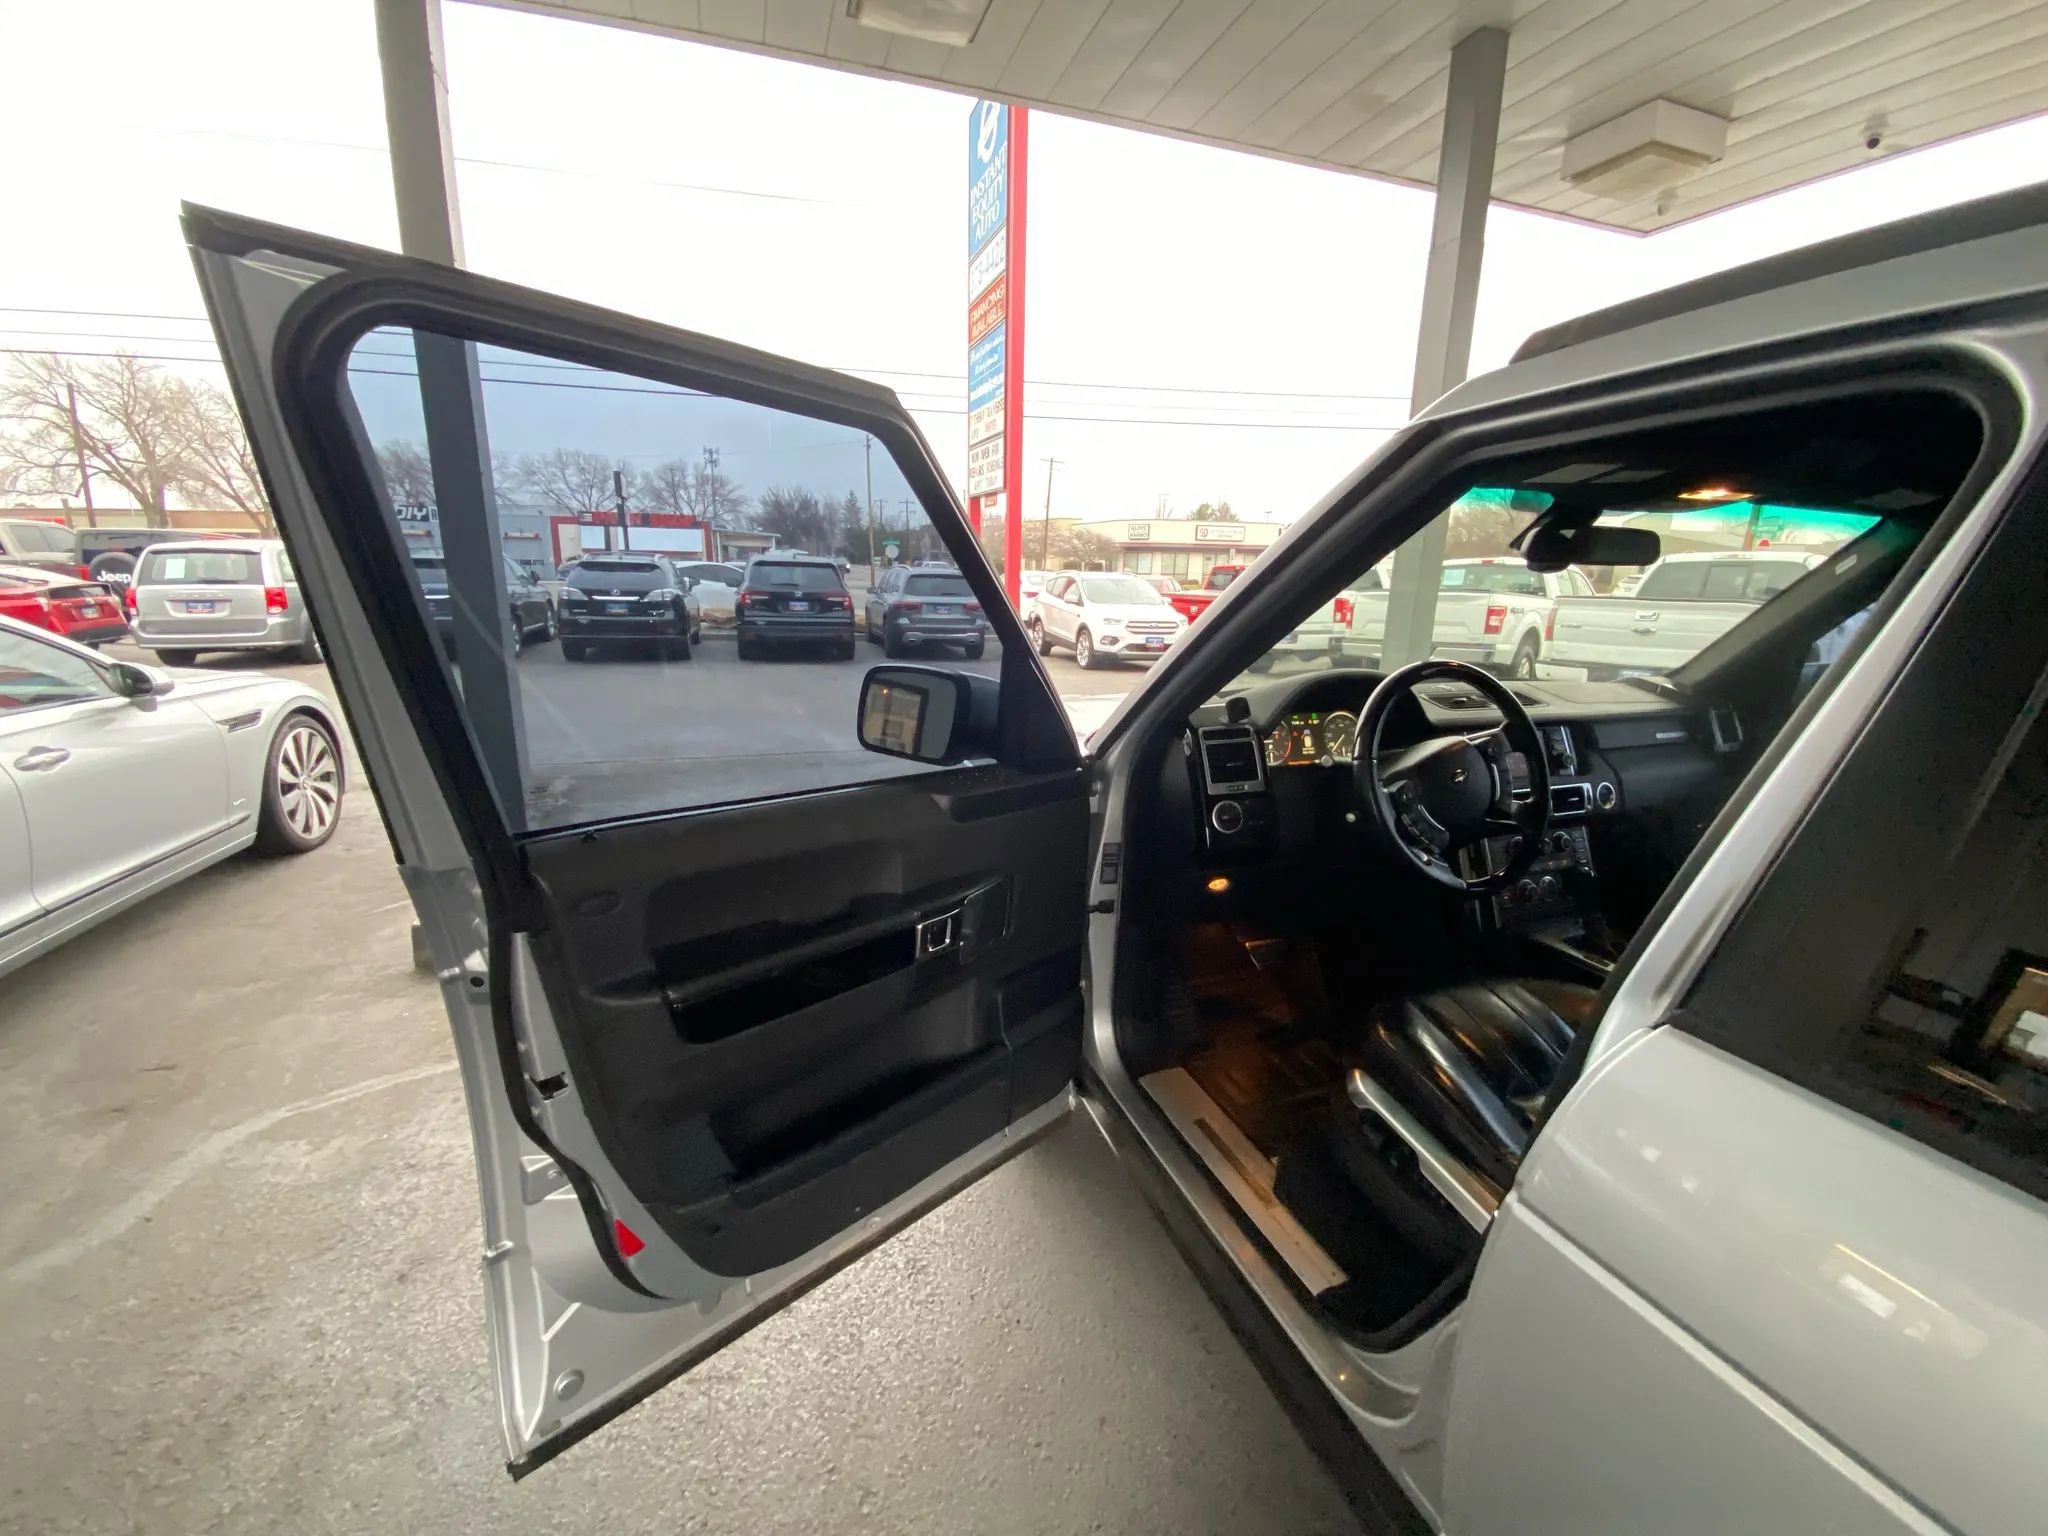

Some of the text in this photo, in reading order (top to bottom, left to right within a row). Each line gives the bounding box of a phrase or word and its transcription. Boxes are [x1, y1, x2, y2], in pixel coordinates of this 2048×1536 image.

[971, 142, 1006, 208] INSTANT
[973, 168, 1004, 226] EQUITY
[975, 200, 999, 245] AUTO
[97, 570, 131, 583] Jeep
